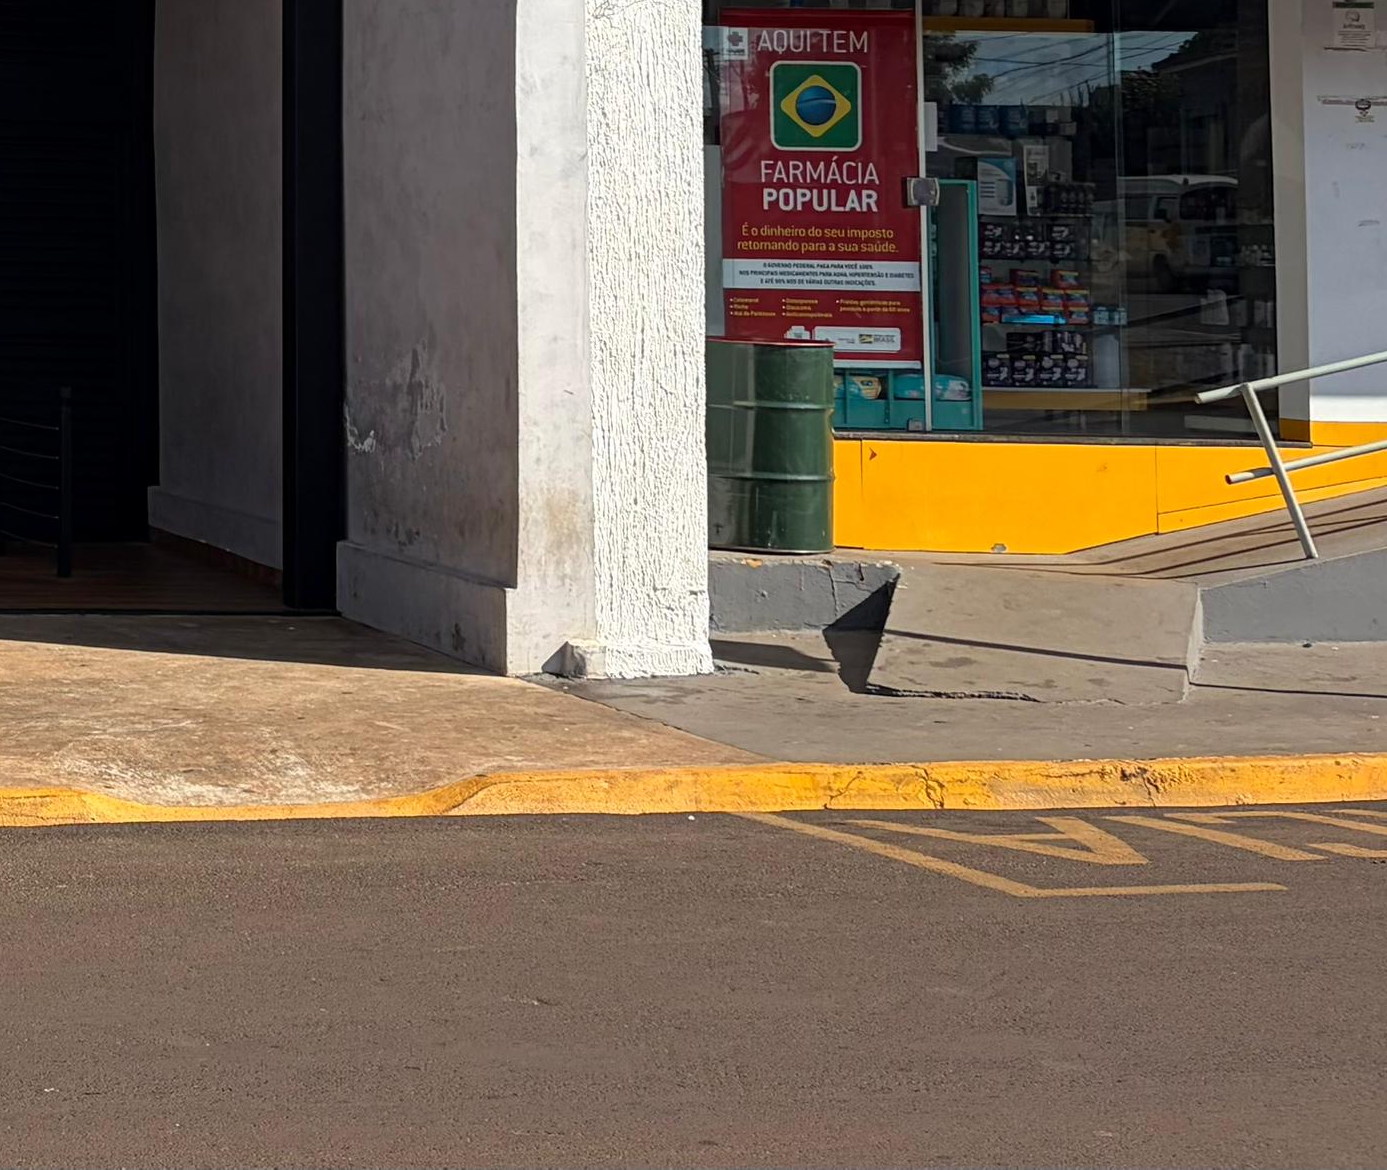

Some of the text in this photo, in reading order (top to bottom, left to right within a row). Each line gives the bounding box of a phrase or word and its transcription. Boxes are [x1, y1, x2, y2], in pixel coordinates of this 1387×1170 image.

[757, 30, 869, 55] AQUI TEM
[760, 156, 880, 185] FARMÁCIA
[762, 188, 879, 213] POPULAR
[741, 222, 894, 241] É o dinheiro do seu imposto
[737, 239, 800, 251] retornando
[801, 242, 826, 254] para
[828, 243, 836, 252] a
[838, 243, 859, 252] sua
